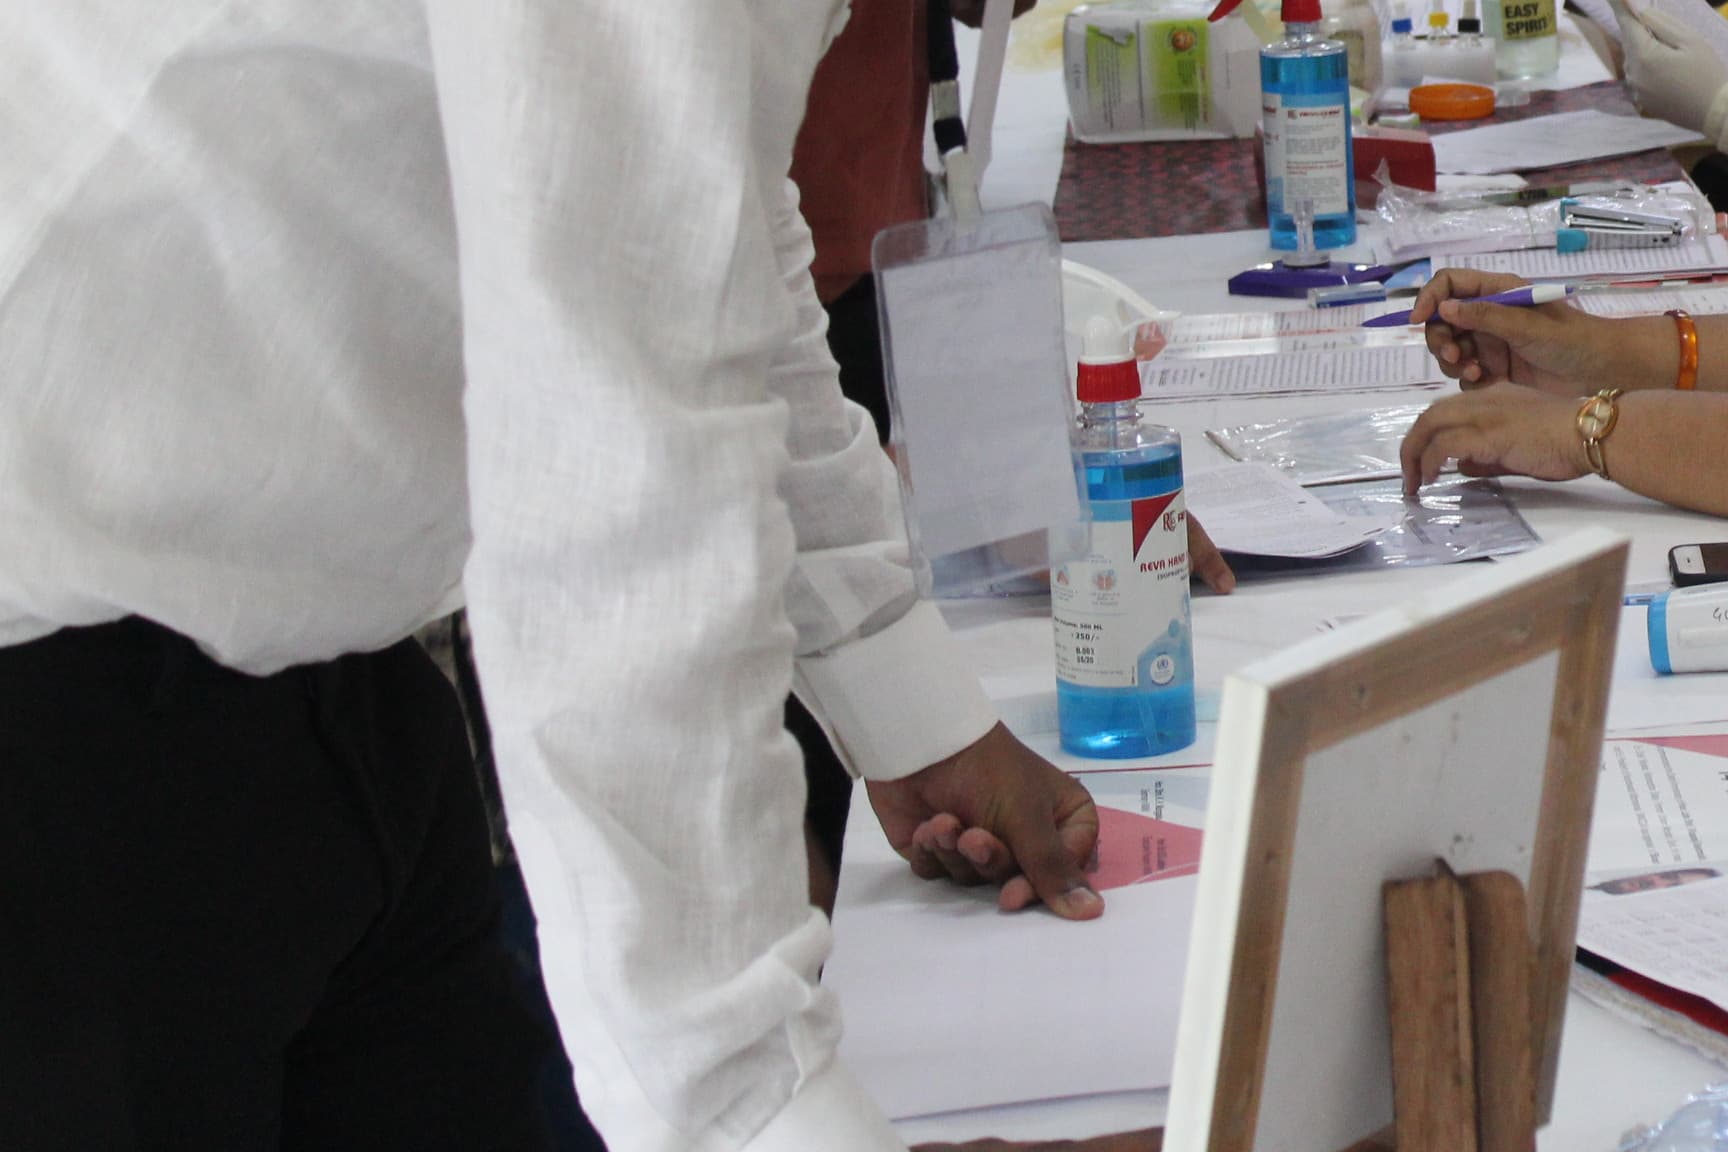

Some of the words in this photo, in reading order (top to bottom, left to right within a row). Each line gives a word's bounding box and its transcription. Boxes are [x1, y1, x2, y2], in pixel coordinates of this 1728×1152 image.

[1504, 2, 1539, 19] EASY
[1506, 16, 1549, 35] SPIRIT
[1140, 559, 1166, 573] REVA
